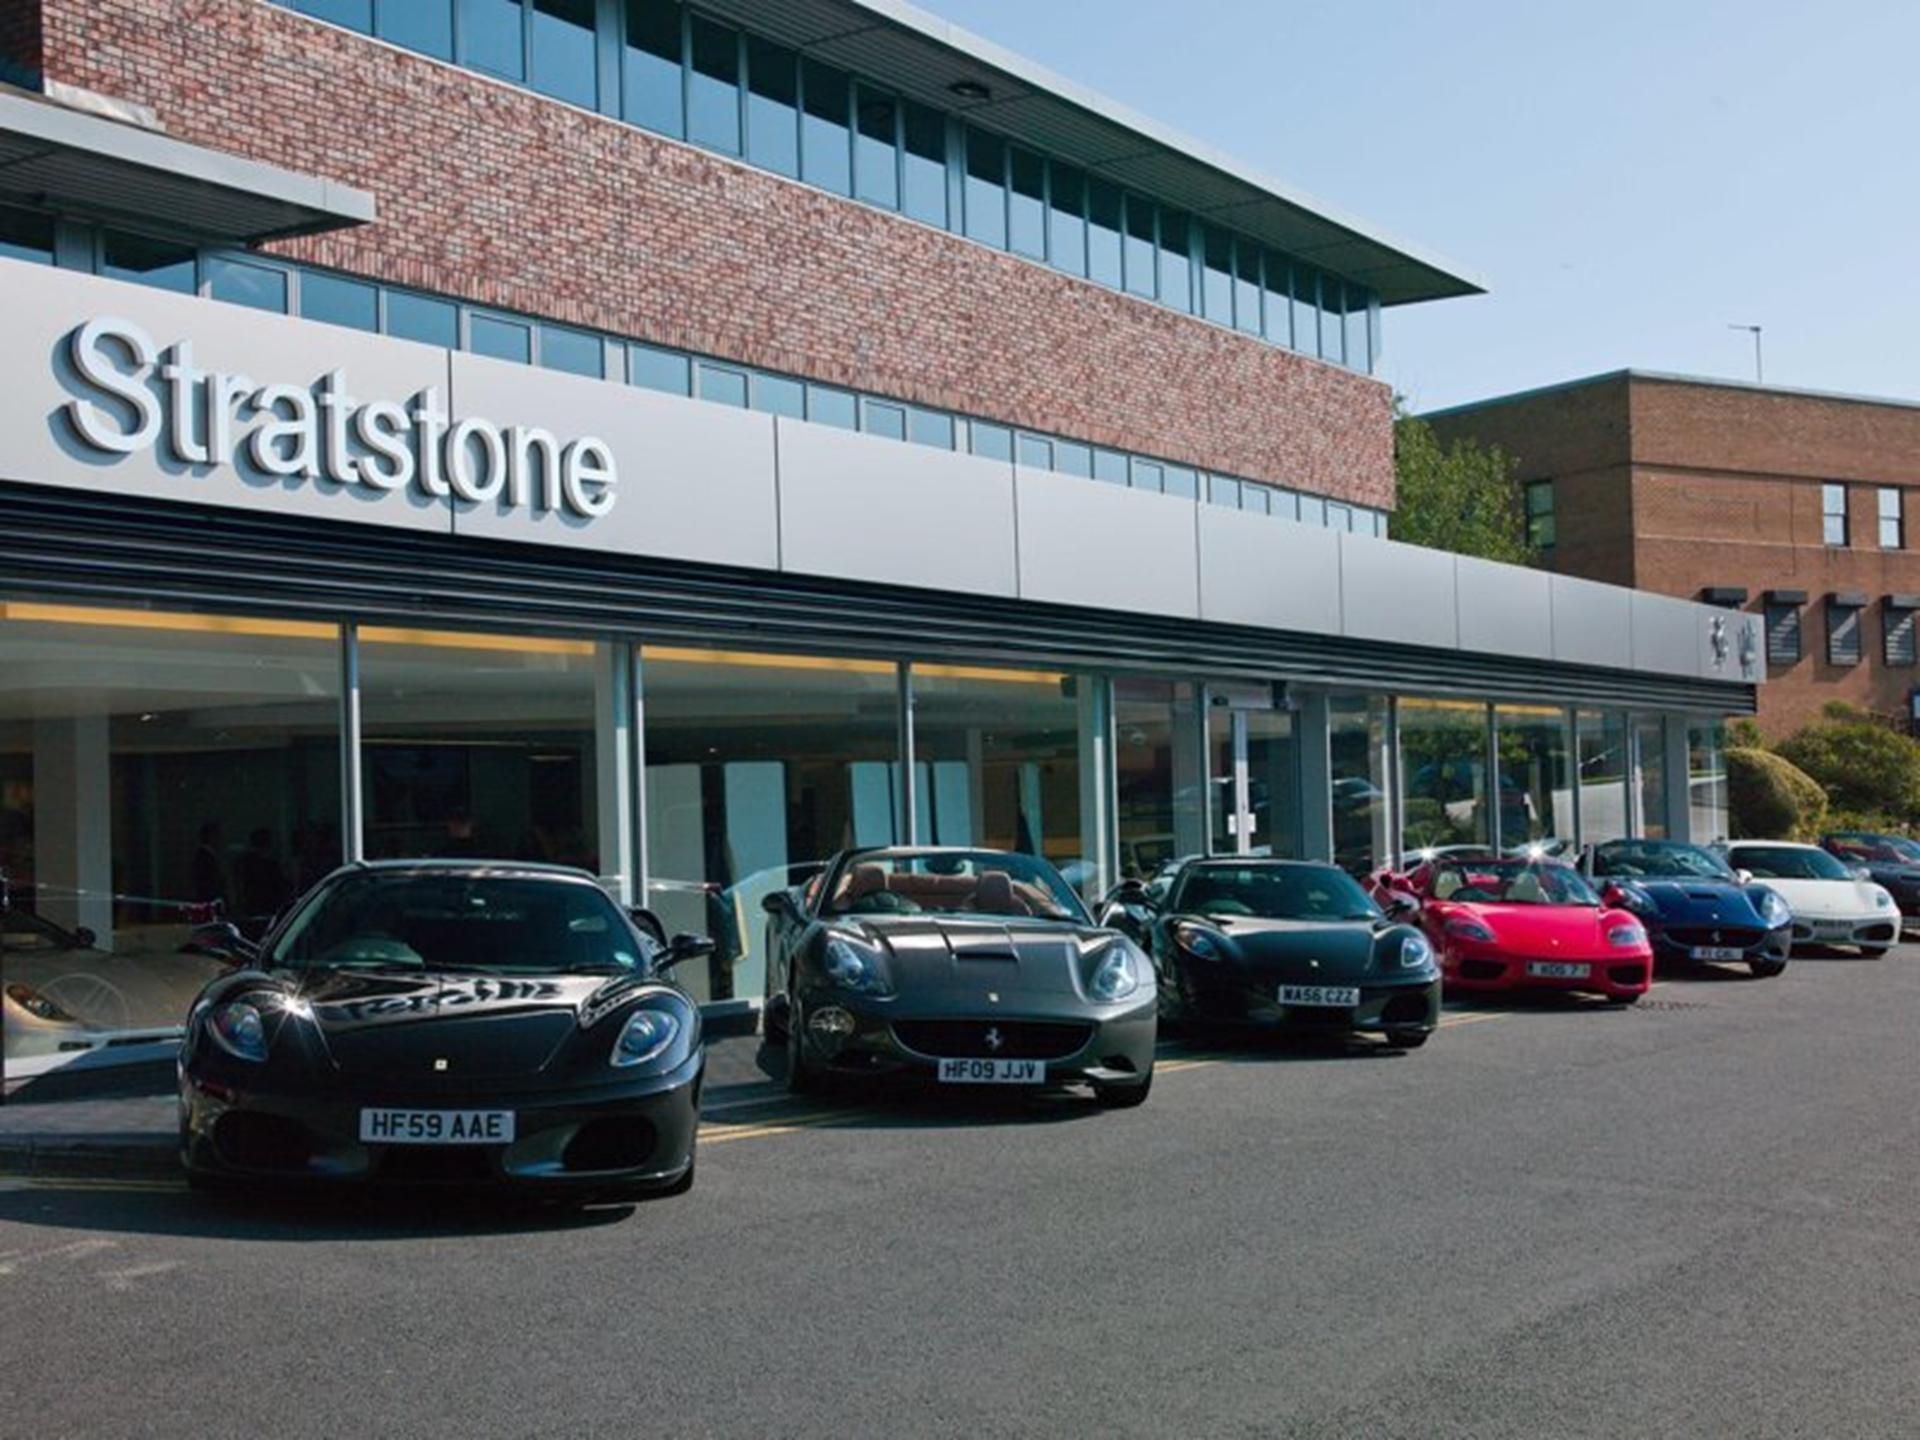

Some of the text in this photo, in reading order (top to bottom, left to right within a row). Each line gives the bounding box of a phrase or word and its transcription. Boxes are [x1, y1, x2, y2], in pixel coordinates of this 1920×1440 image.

[52, 315, 617, 519] Stratstone
[1283, 987, 1322, 1002] WA56
[944, 1061, 1036, 1079] HF09 JJV
[371, 1112, 502, 1138] HF59 AAE
